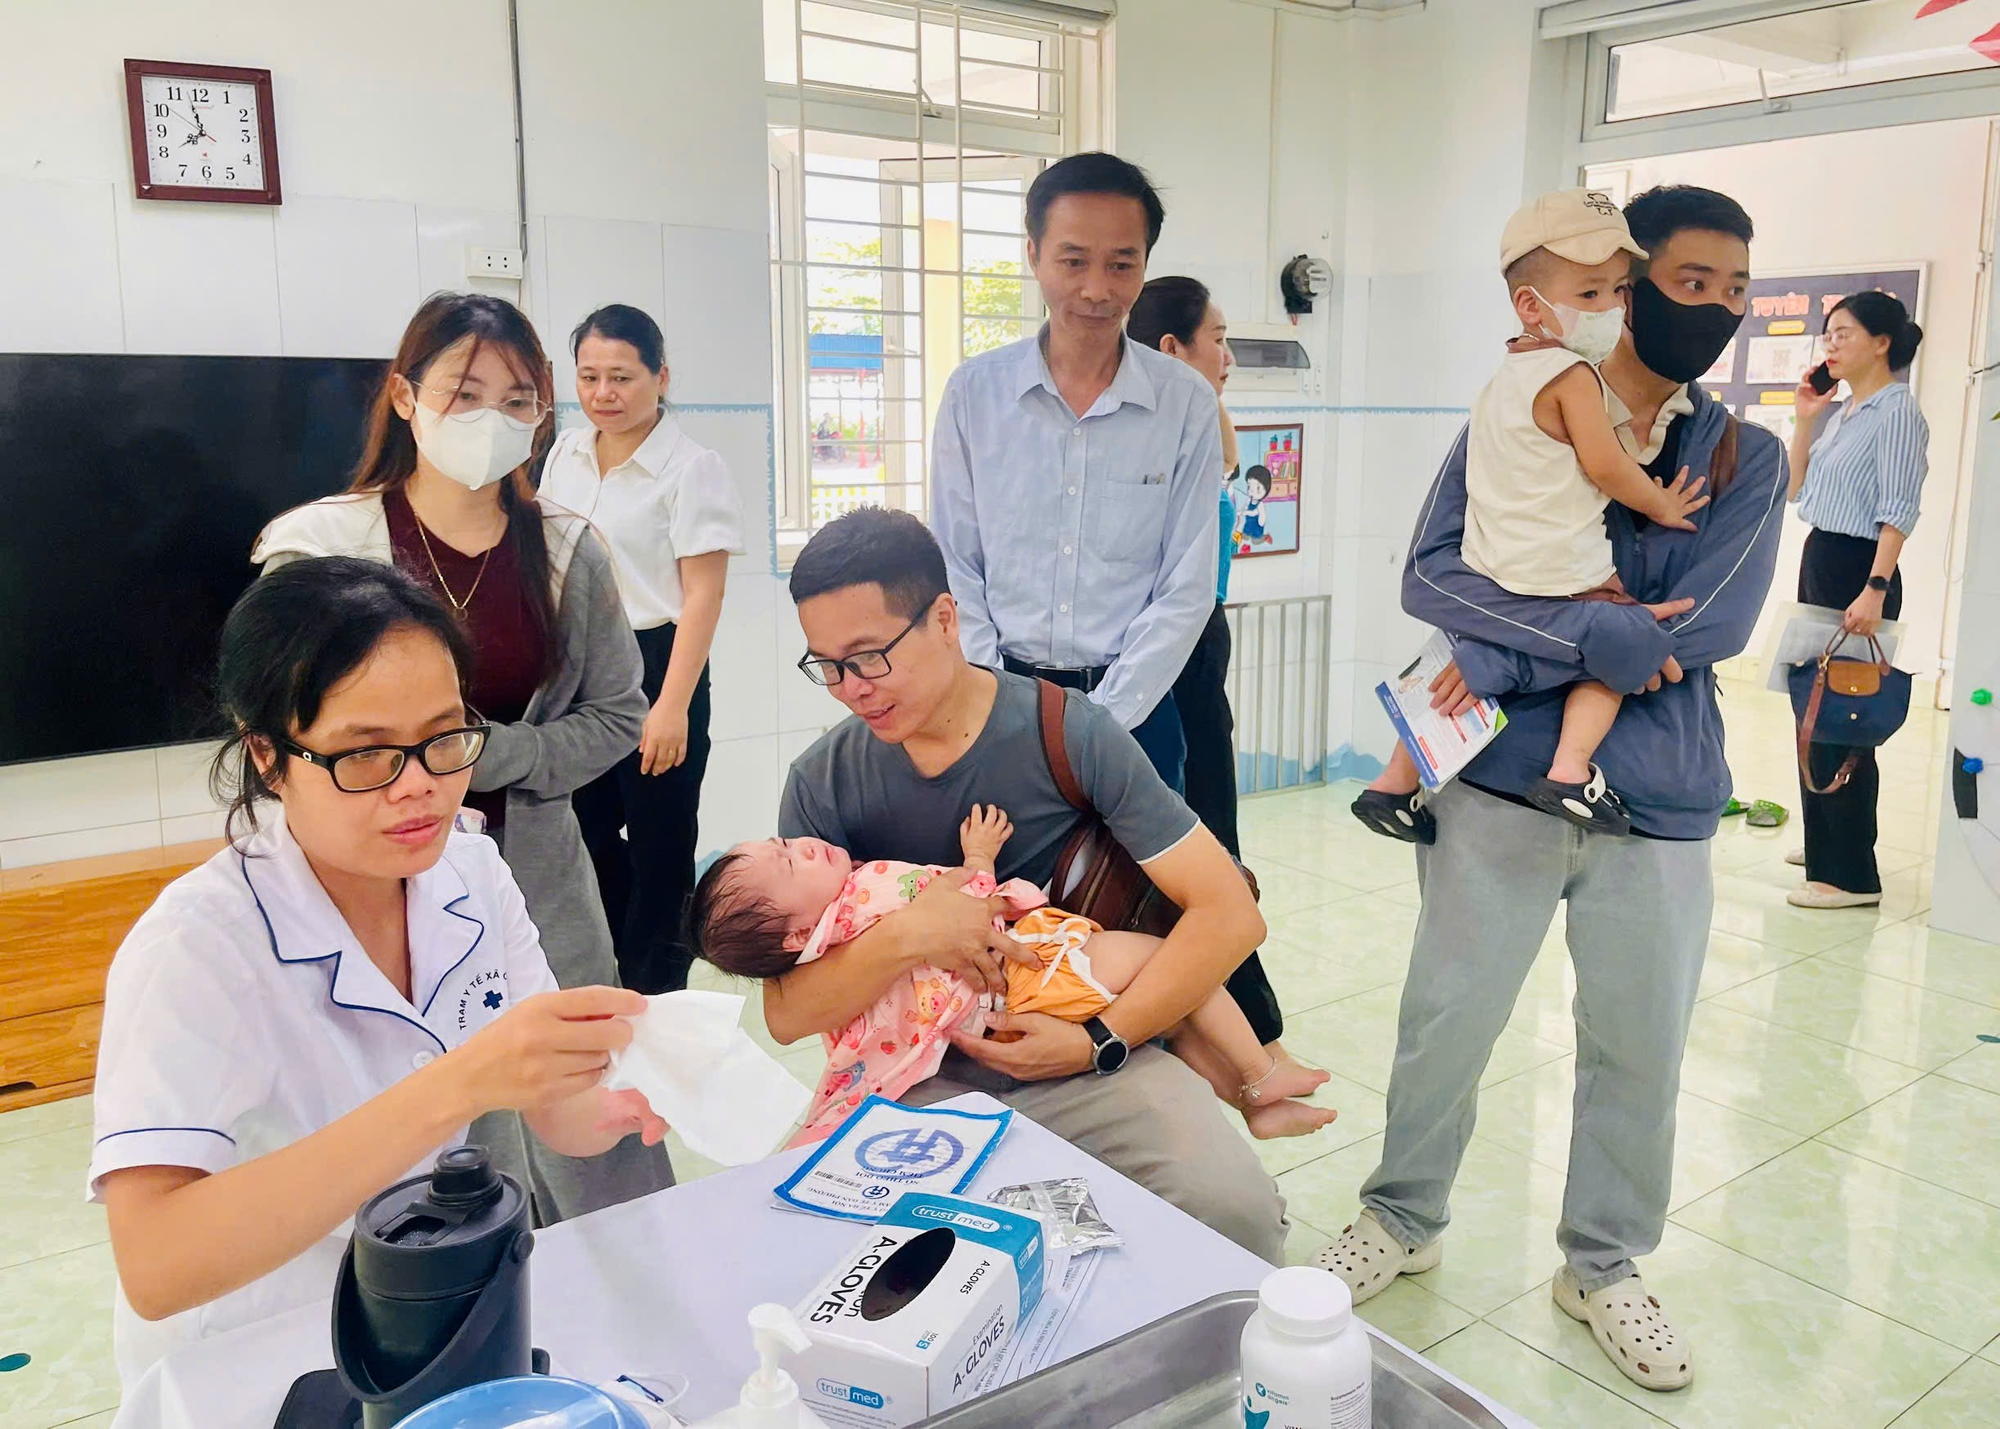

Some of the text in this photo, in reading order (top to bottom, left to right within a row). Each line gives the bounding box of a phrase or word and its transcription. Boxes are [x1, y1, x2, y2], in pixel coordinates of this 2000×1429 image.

[167, 86, 183, 101] 11
[191, 88, 209, 103] 12
[223, 91, 231, 104] 1
[154, 103, 170, 118] 10
[239, 109, 249, 122] 2
[157, 124, 167, 138] 9
[241, 130, 251, 143] 3
[159, 146, 169, 158] 8
[242, 154, 252, 165] 4
[178, 164, 188, 177] 7
[201, 166, 212, 179] 6
[225, 167, 235, 180] 5
[463, 989, 471, 997] Y
[485, 969, 500, 981] XÃ
[918, 1206, 994, 1230] trust med
[810, 1236, 898, 1324] A-GLOVES
[952, 1315, 1005, 1395] A-GLOVES
[820, 1382, 879, 1406] trust med
